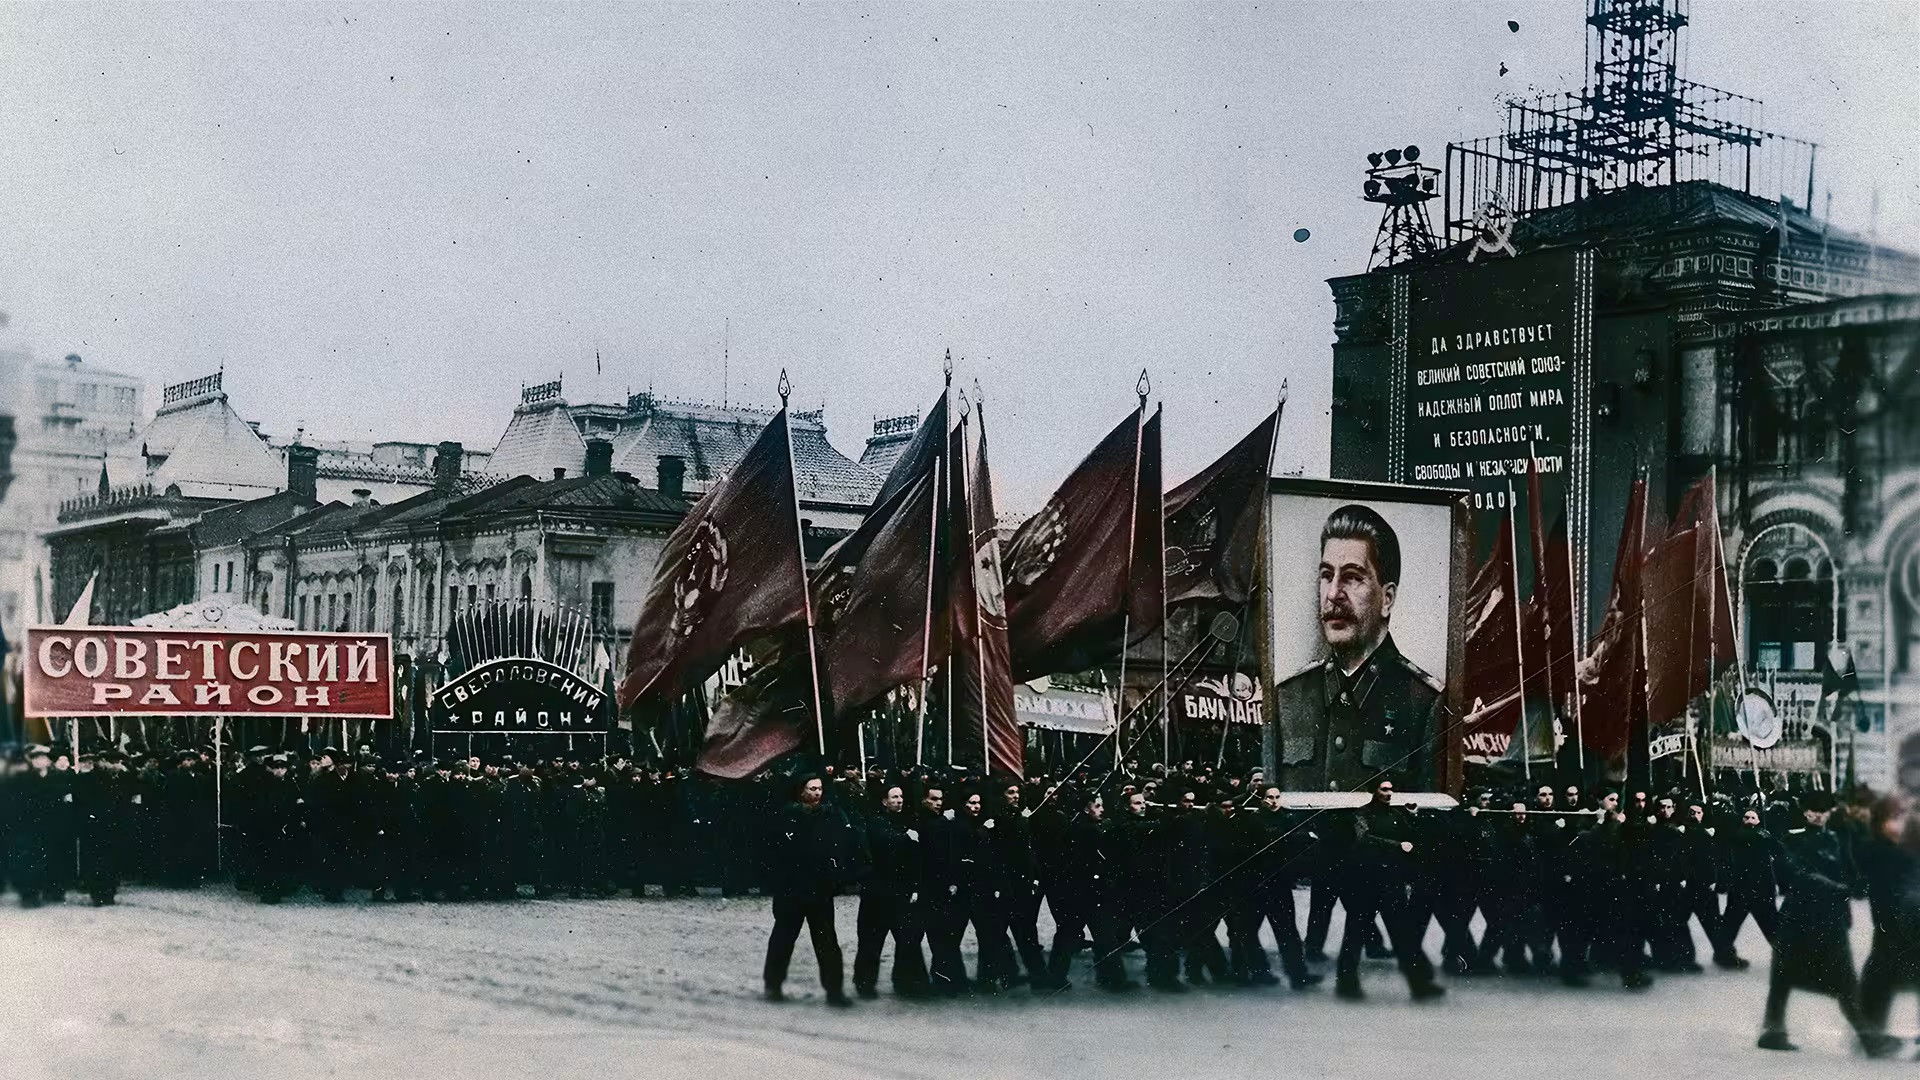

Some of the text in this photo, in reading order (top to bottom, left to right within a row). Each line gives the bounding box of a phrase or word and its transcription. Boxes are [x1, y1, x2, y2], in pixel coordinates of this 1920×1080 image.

[1431, 323, 1553, 355] ДА ЗДРАВСТВУЕТ
[1417, 355, 1566, 386] ВЕЛИКИЙ СОВЕТСКИЙ СОЮЗ-
[1418, 388, 1564, 418] НАДЕЖНЫЙ ОПЛОТ МИРА
[1433, 433, 1441, 448] И
[1415, 462, 1461, 481] СВОБОДЫ
[1466, 461, 1474, 478] И
[38, 635, 378, 683] СОВЕТСКИЙ
[91, 681, 331, 707] РАЙОН
[441, 665, 601, 710] СВЕРДЛОВСКИЙ
[472, 707, 572, 728] РАЙОН
